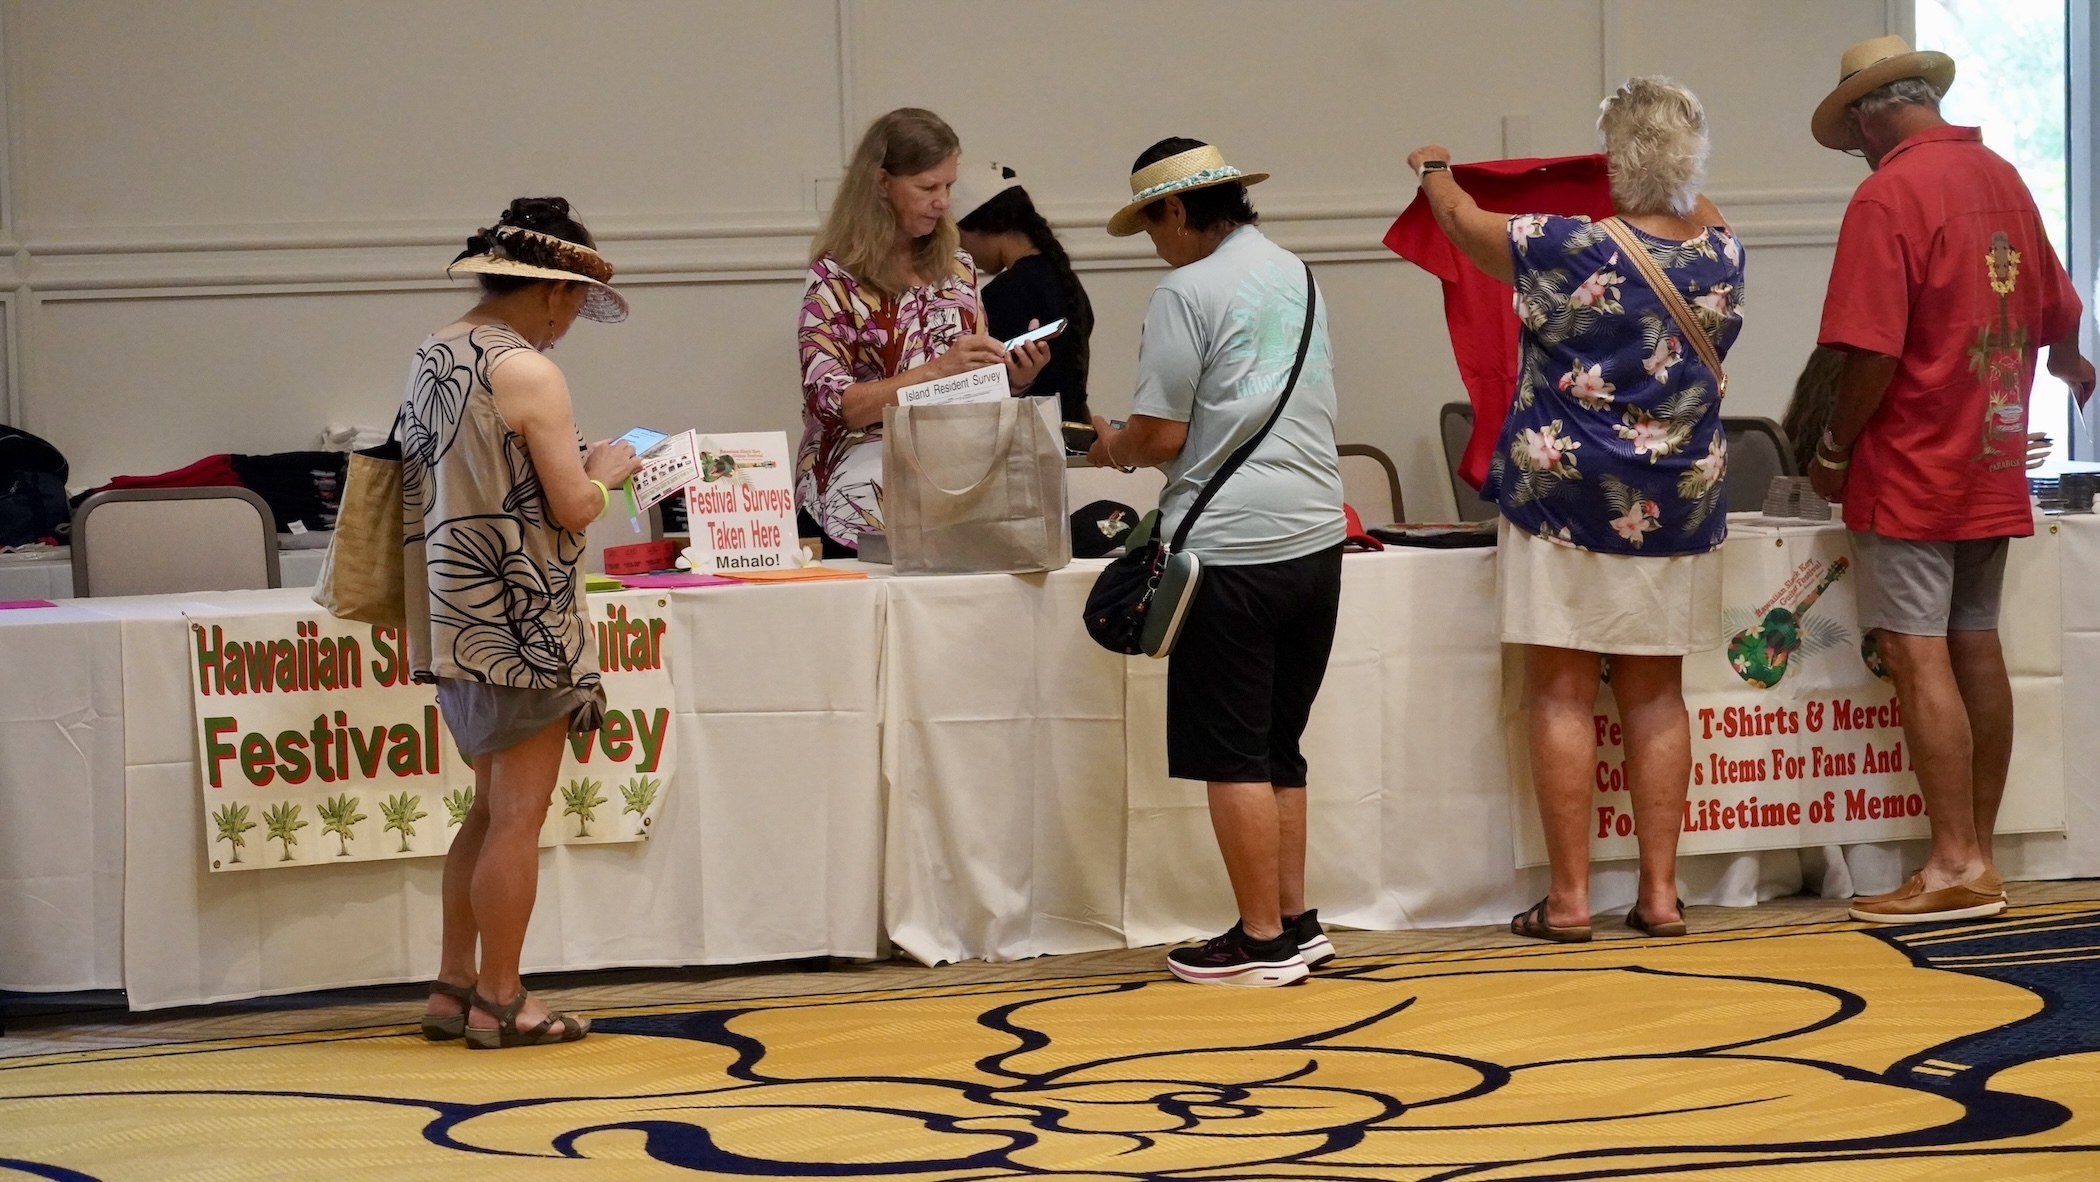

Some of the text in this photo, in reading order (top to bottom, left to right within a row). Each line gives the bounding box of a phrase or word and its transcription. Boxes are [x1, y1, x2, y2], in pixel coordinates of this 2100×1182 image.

[905, 386, 930, 402] Island
[933, 377, 970, 395] Resident
[973, 371, 1001, 387] Survey
[689, 482, 792, 518] Festival Surveys
[707, 519, 781, 550] Taken Here
[716, 553, 780, 569] Mahalo!
[196, 620, 362, 697] Hawaiian
[1698, 696, 1904, 740] T-Shirts & Merch
[203, 705, 440, 788] Festival
[1710, 752, 1766, 785] Items
[1772, 749, 1806, 781] For
[1811, 746, 1856, 778] Fans
[1862, 742, 1902, 775] And
[1597, 788, 1929, 839] Fo Lifetime of Memo
